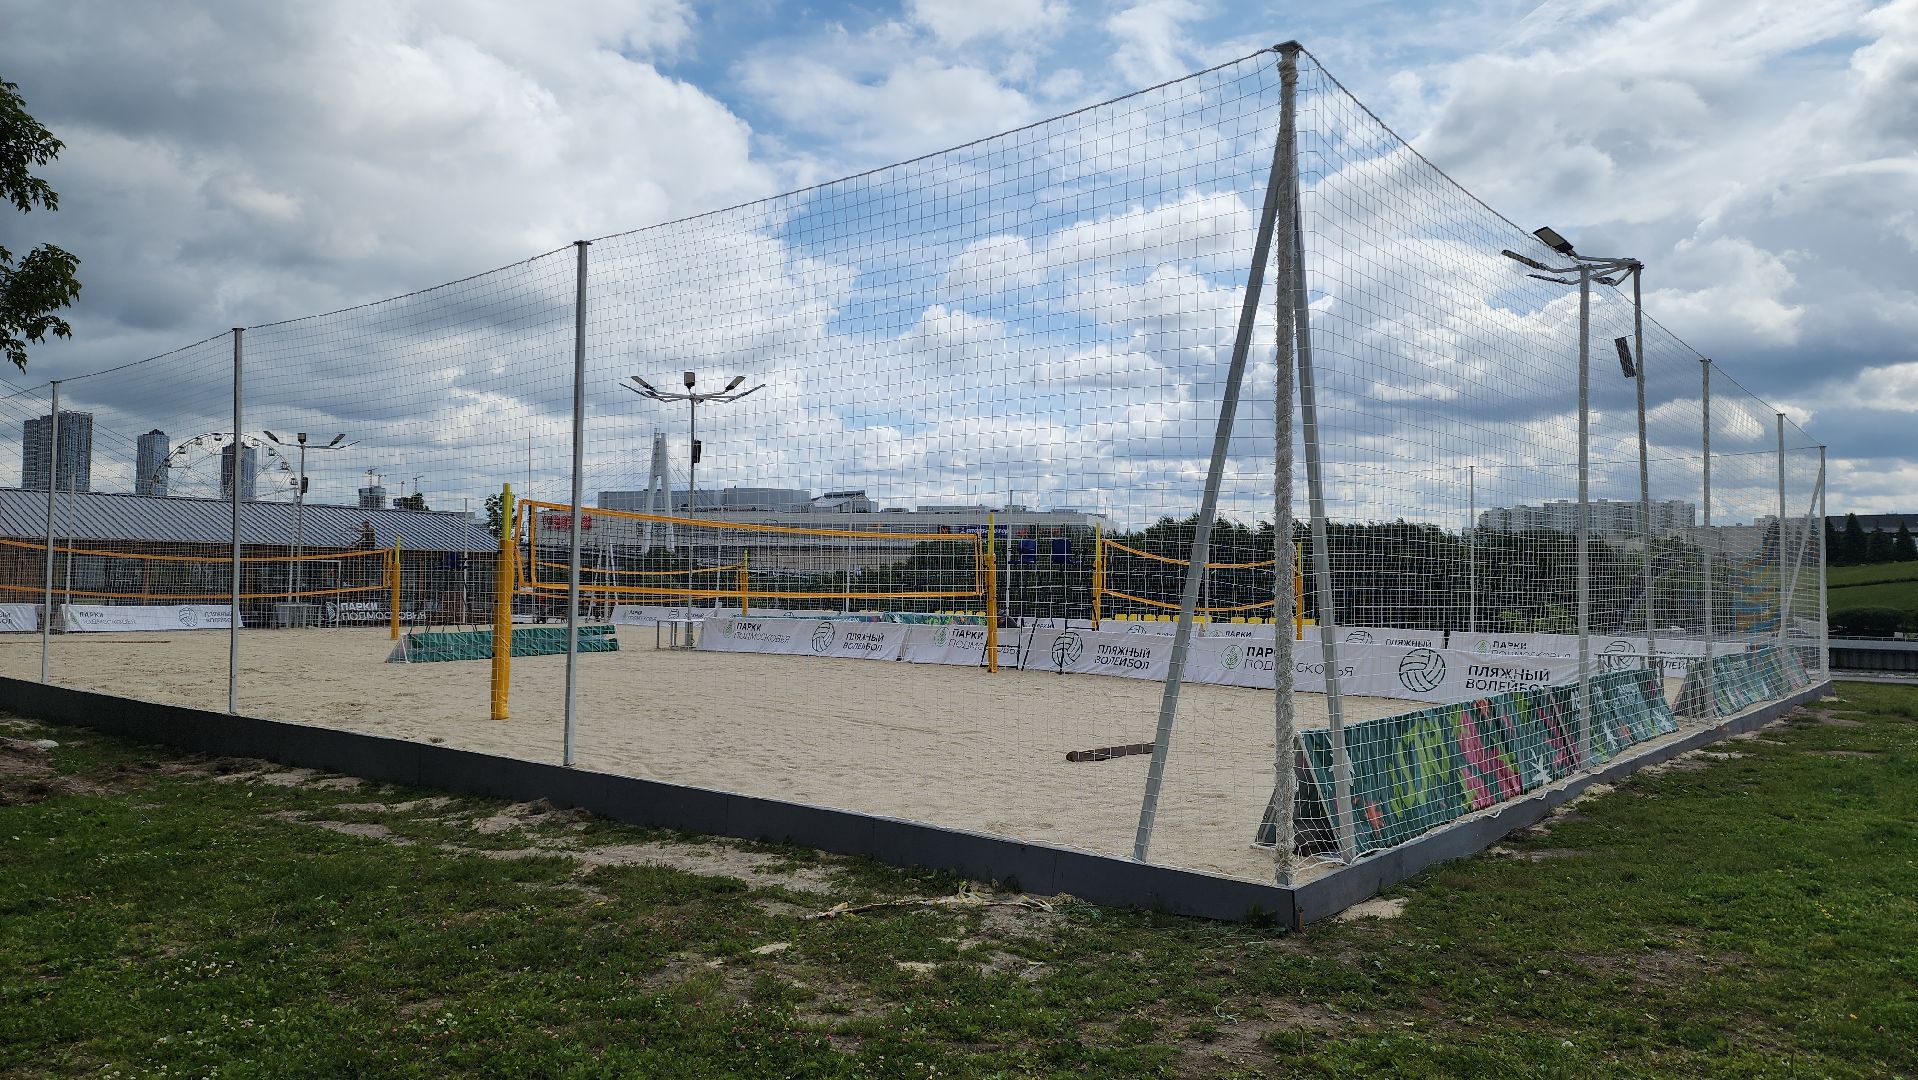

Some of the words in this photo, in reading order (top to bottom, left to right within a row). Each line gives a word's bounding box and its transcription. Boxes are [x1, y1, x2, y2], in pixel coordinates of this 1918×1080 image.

[341, 602, 378, 611] ПАРКИ
[341, 611, 426, 620] ПОДМОСОВЬЯ
[736, 622, 762, 632] ПАРКИ
[846, 632, 885, 643] ПЛЯЖНЫЙ
[952, 628, 984, 640] ПАРКИ
[1225, 630, 1252, 638] ПАРКИ
[1385, 638, 1432, 648] ПЛЯЖНЫЙ
[1493, 640, 1527, 650] ПАРКИ
[1098, 644, 1150, 659] ПЛЯЖНЫЙ
[1245, 646, 1275, 658] ПАР
[1094, 655, 1150, 670] ВОЛЕЙБОЛ
[1468, 665, 1550, 682] ПЛЯЖНЫЙ
